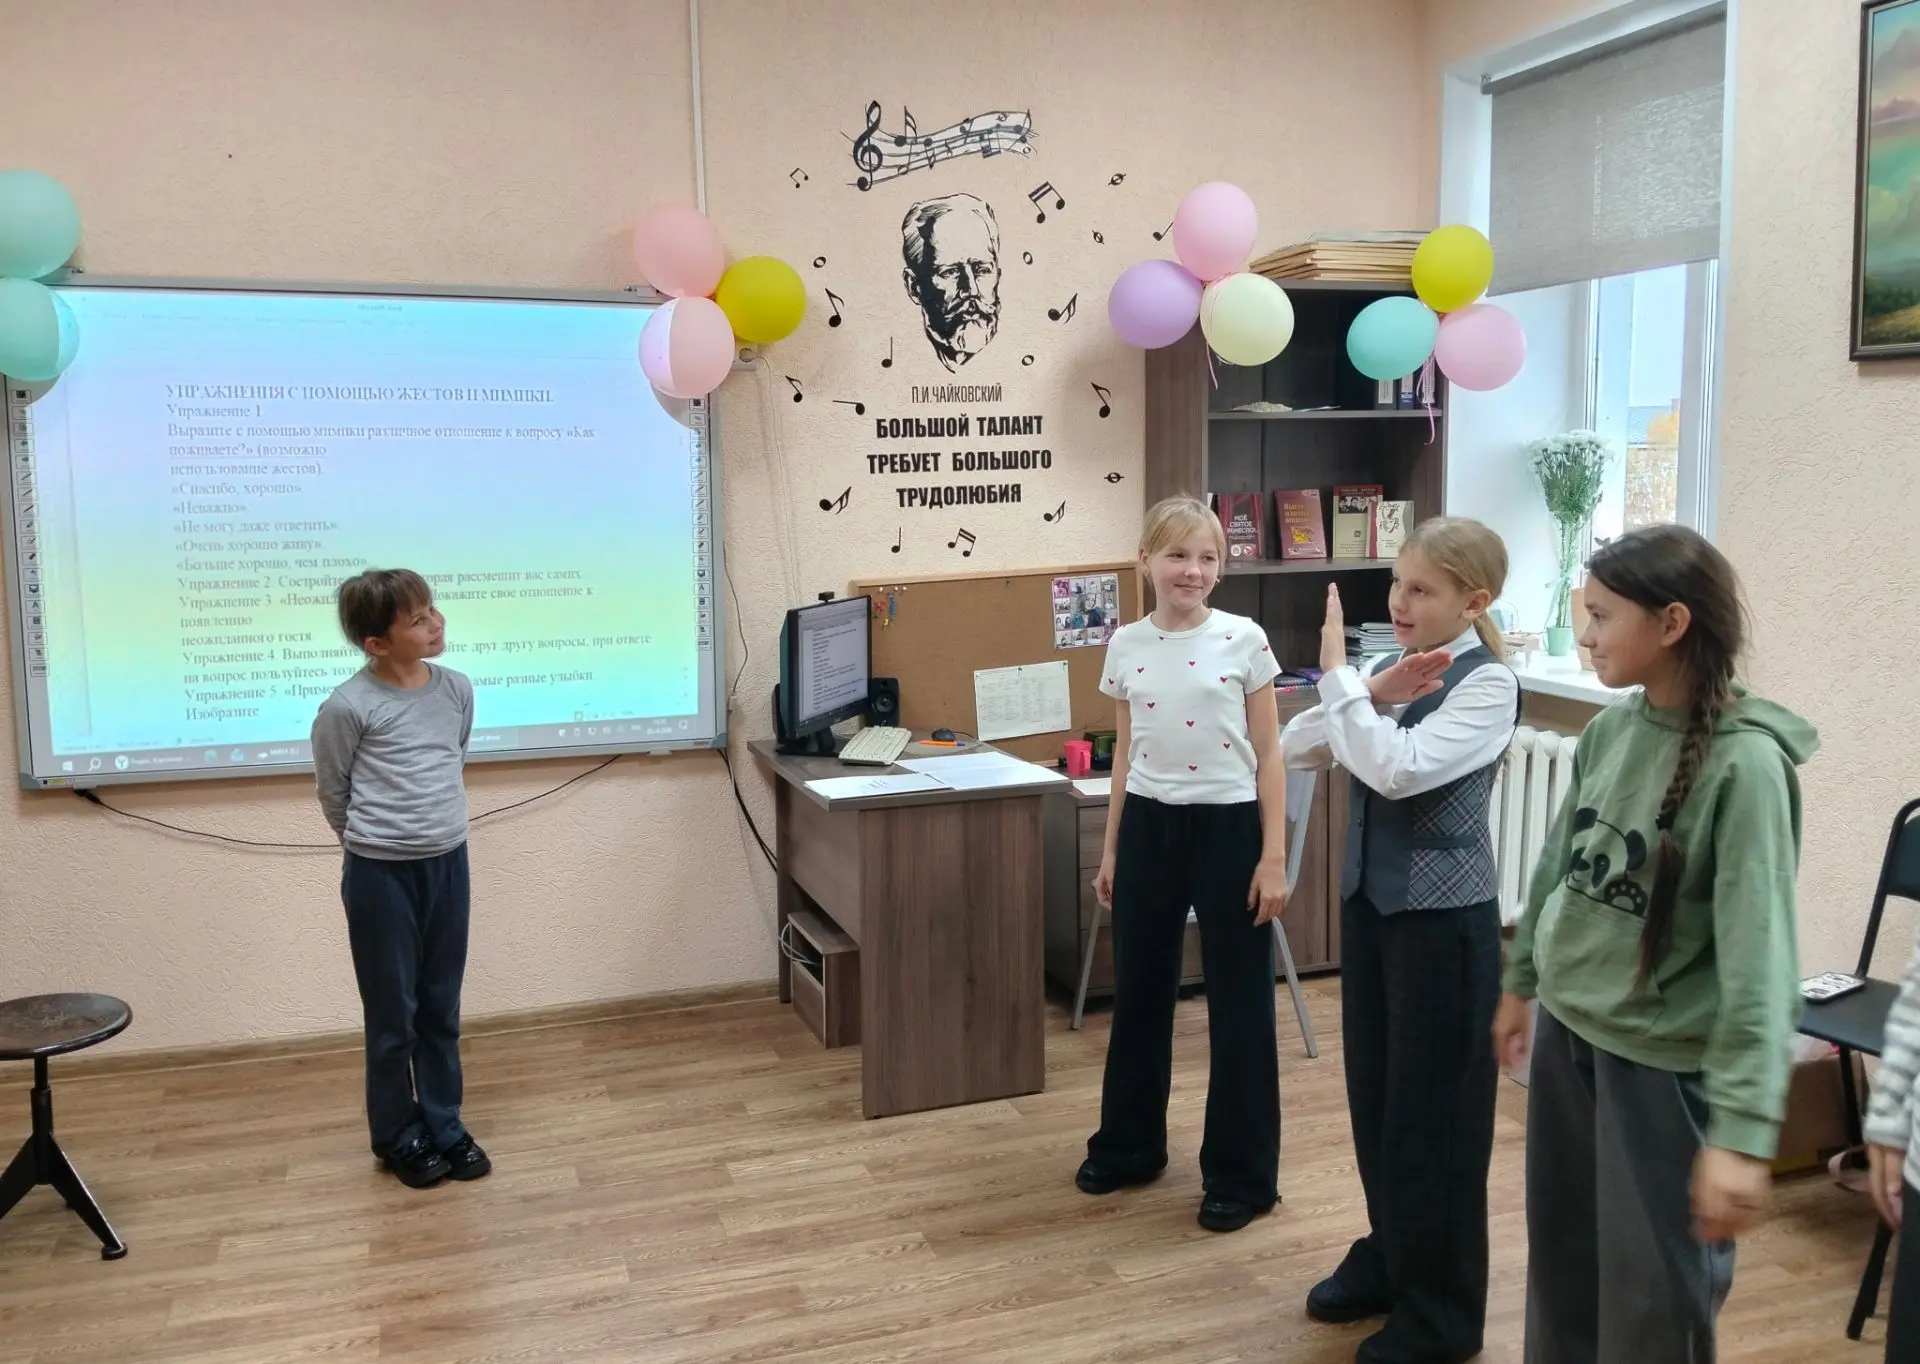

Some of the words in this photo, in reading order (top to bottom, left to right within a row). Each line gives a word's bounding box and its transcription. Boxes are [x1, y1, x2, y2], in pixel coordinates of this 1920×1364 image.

[165, 383, 285, 400] УПРАЖНЕНИЯ
[287, 386, 299, 400] С
[302, 386, 394, 402] ПОМОЩЬЮ
[398, 387, 464, 401] ЖЕСТОВ
[467, 388, 478, 402] И
[912, 382, 1002, 404] П.И.ЧАЙКОВСКИЙ
[167, 403, 250, 420] Упражнение
[168, 422, 232, 440] Выразите
[236, 426, 244, 437] с
[247, 426, 311, 438] помощью
[314, 426, 365, 438] мимики
[367, 426, 431, 440] различное
[435, 426, 502, 438] отношение
[505, 427, 513, 438] к
[516, 427, 563, 441] вопросу
[567, 425, 596, 438] «Как
[876, 413, 970, 439] БОЛЬШОЙ
[976, 415, 1043, 437] ТАЛАНТ
[170, 463, 268, 476] использование
[867, 452, 941, 474] ТРЕБУЕТ
[952, 449, 1052, 472] БОЛЬШОГО
[896, 483, 1022, 509] ТРУДОЛЮБИЯ
[203, 522, 234, 536] могу
[236, 521, 271, 533] даже
[227, 540, 279, 554] хорошо
[294, 558, 318, 568] чем
[177, 577, 260, 594] Упражнение
[457, 570, 522, 586] рассмешит
[525, 571, 544, 581] вас
[178, 595, 261, 612] Упражнение
[490, 588, 517, 599] свое
[519, 586, 584, 599] отношение
[586, 585, 595, 597] к
[180, 615, 253, 629] появлению
[181, 633, 275, 648] неожиданного
[182, 650, 264, 668] Упражнение
[282, 645, 361, 661] Выполняйте
[471, 642, 497, 655] друг
[503, 640, 535, 655] другу
[592, 637, 613, 650] при
[616, 633, 652, 647] ответе
[184, 673, 200, 684] на
[203, 670, 247, 687] вопрос
[250, 667, 328, 684] пользуйтесь
[184, 686, 267, 705] Упражнение
[506, 672, 547, 689] разные
[186, 705, 260, 722] Изобразите
